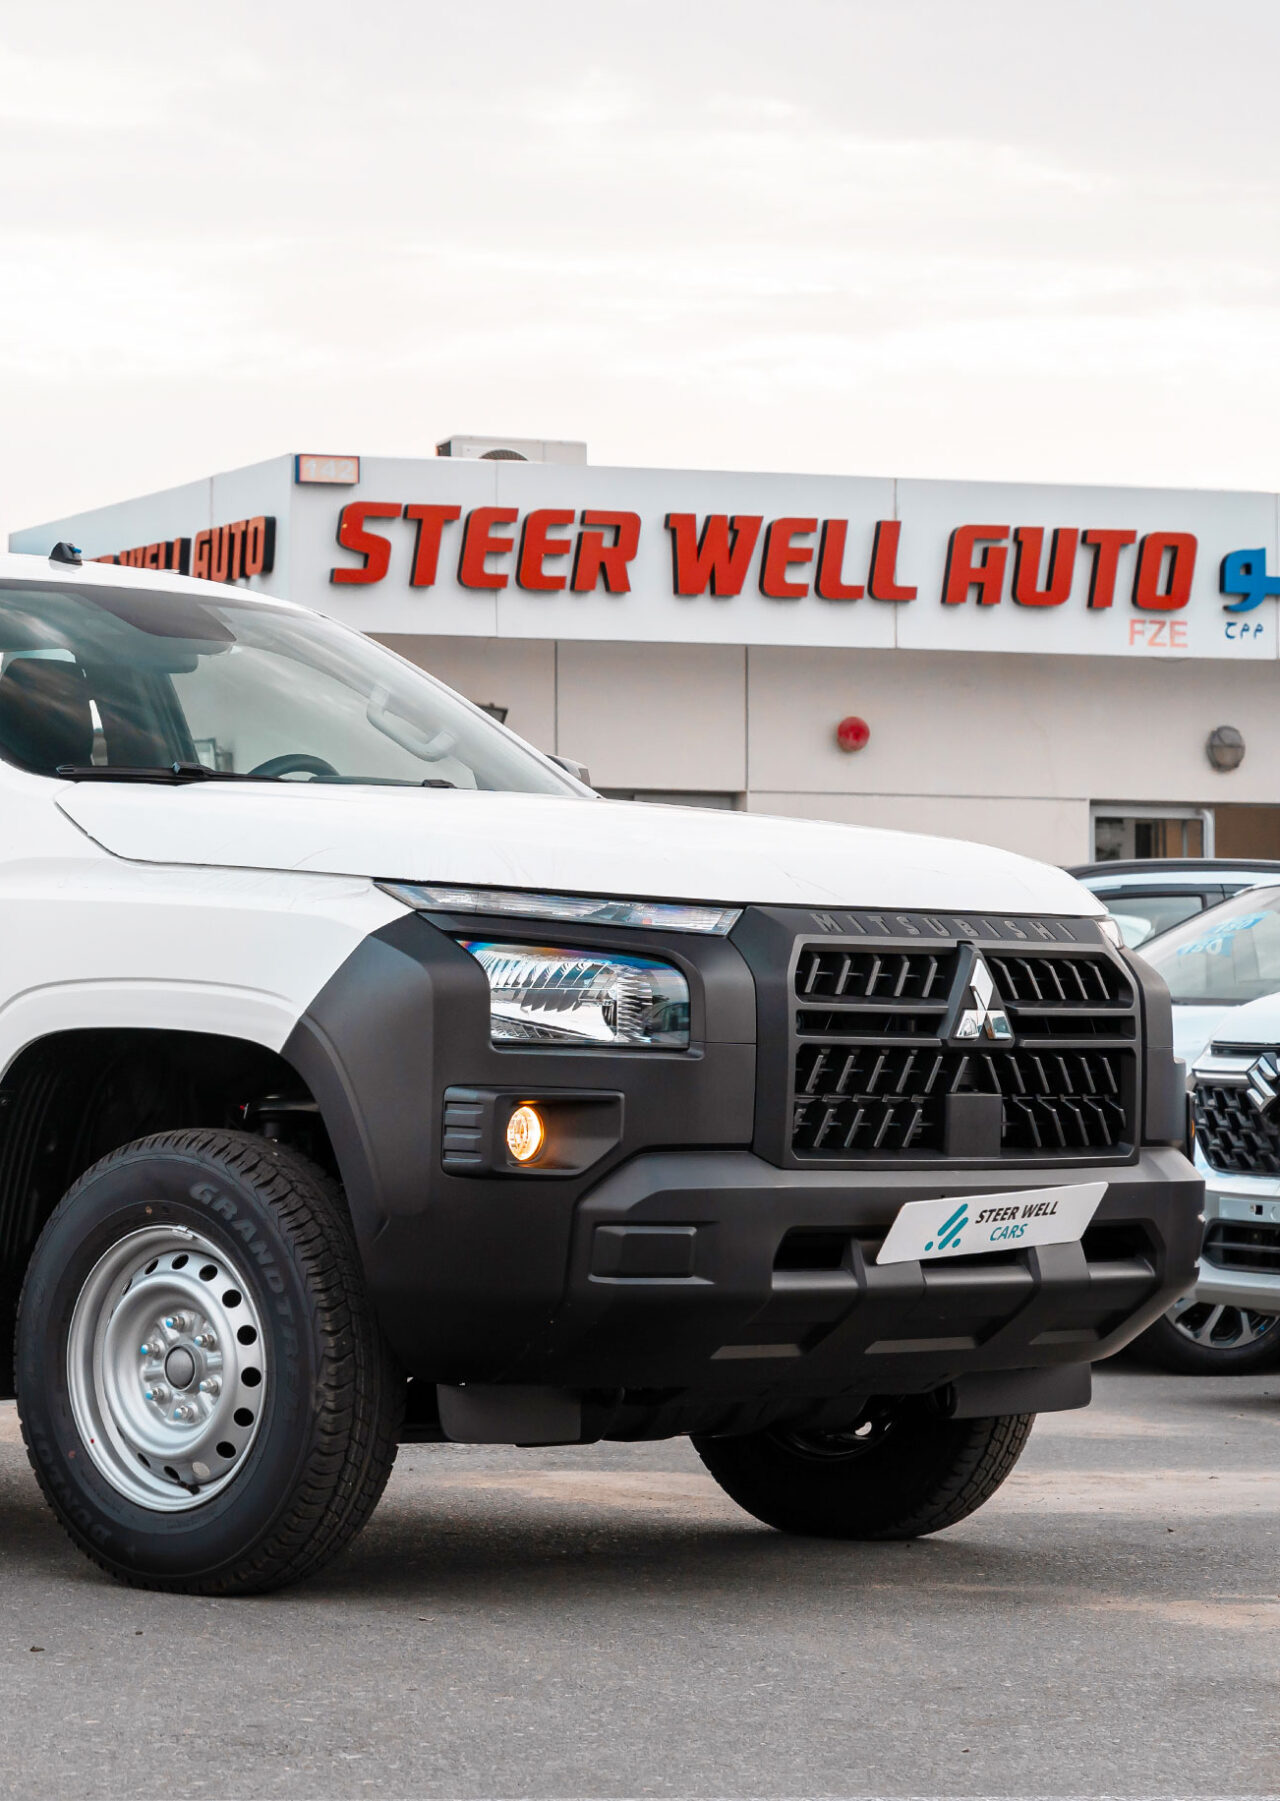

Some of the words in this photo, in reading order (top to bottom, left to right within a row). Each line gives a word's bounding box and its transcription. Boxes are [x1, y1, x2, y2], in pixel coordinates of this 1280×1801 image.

[305, 458, 356, 481] 142
[193, 516, 276, 583] AUTO
[330, 501, 641, 593] STEER
[664, 513, 918, 601] WELL
[940, 525, 1199, 611] AUTO
[1128, 619, 1189, 649] FZE
[810, 912, 1077, 941] MITSUBISHI
[975, 1205, 1020, 1225] STEER
[1021, 1201, 1059, 1218] WELL
[989, 1223, 1029, 1242] CARS
